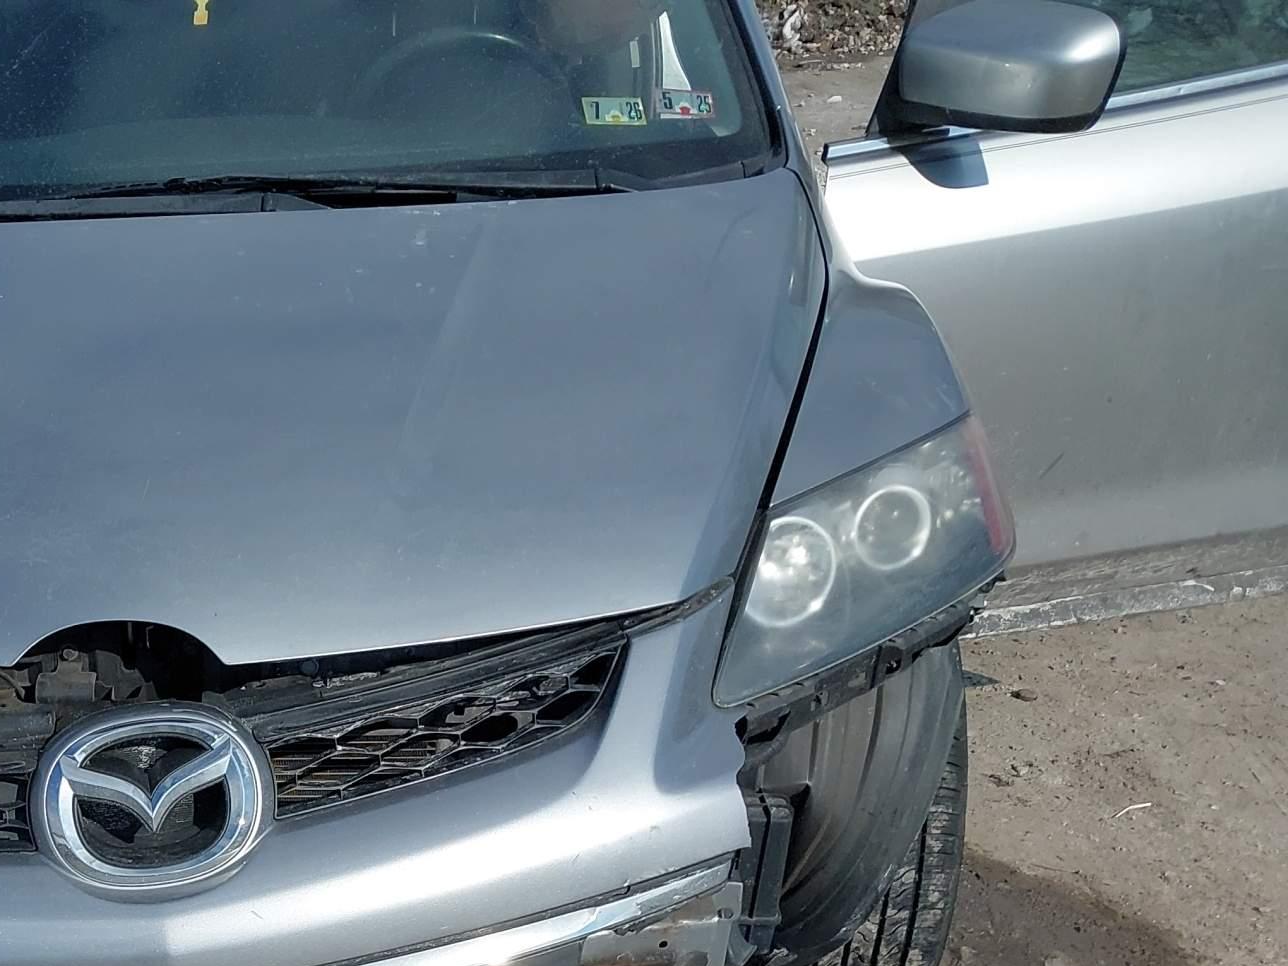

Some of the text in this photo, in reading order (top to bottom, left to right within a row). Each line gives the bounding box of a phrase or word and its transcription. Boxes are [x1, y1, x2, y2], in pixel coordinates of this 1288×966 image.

[591, 101, 643, 121] 7 26
[662, 91, 712, 113] 5 25
